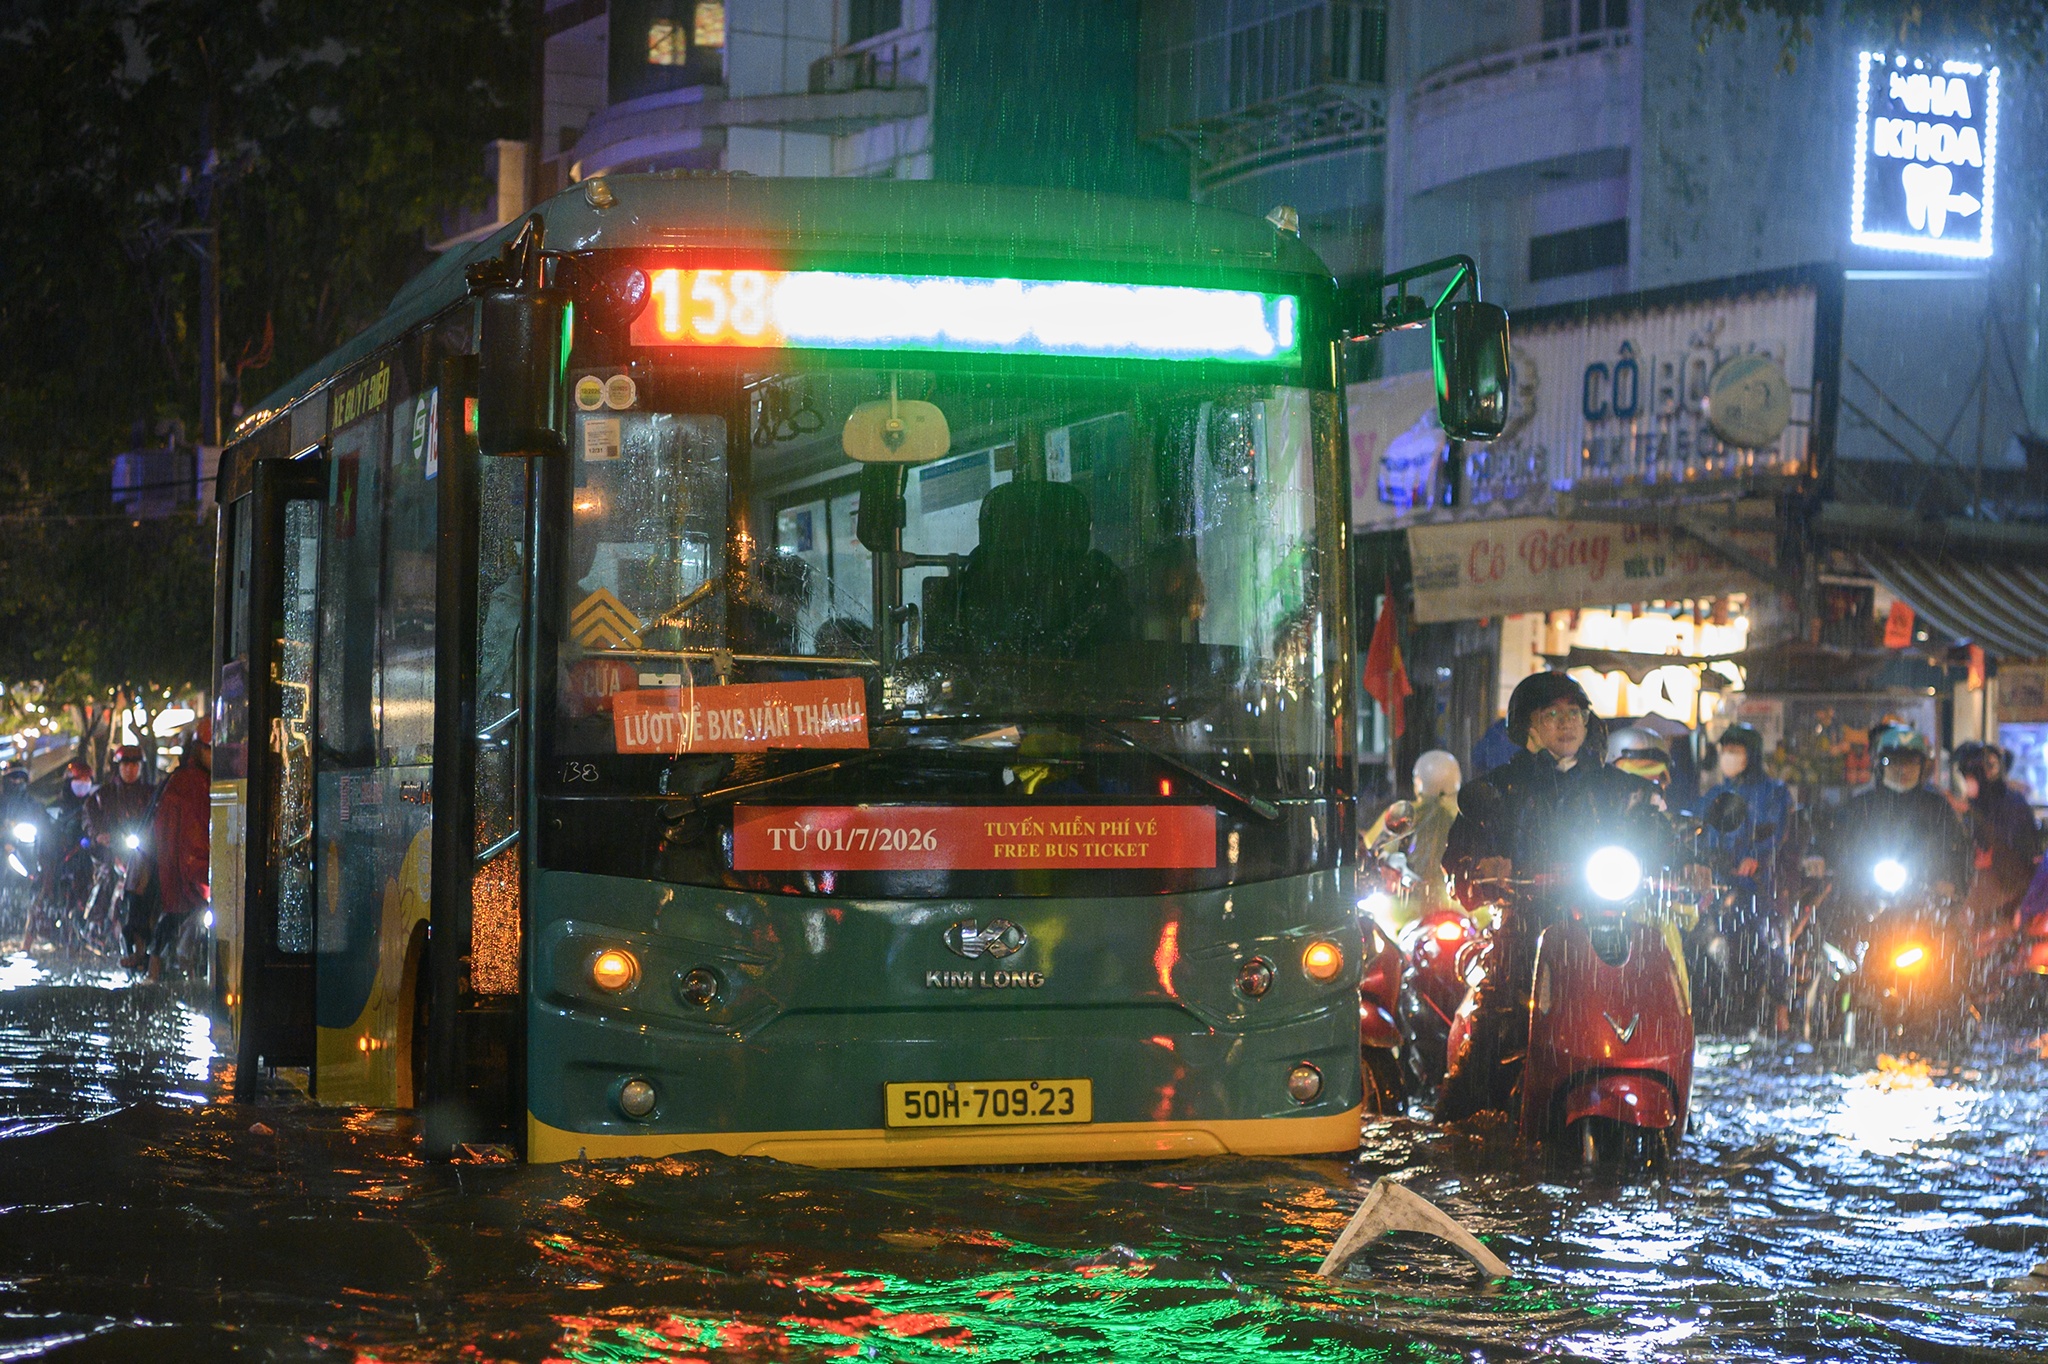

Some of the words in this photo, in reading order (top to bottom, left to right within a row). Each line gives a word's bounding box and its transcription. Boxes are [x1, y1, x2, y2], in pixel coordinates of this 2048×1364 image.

[1874, 117, 1983, 167] KHOA
[652, 268, 767, 335] 158
[1583, 341, 1640, 421] CÔ
[624, 710, 674, 752] LƯỢT
[677, 702, 704, 743] VỀ
[749, 700, 790, 738] VĂN
[793, 697, 862, 737] THÁNH
[767, 821, 811, 851] TỪ
[816, 828, 938, 851] 01/7/2026
[984, 816, 1045, 837] TUYẾN
[1049, 815, 1096, 836] MIỄN
[1100, 818, 1131, 836] PHÍ
[1135, 818, 1158, 836] VÉ
[993, 844, 1040, 858] FREE
[1045, 844, 1079, 858] BUS
[1083, 843, 1150, 858] TICKET
[925, 970, 973, 988] KIM
[980, 970, 1045, 988] LONG
[904, 1087, 1075, 1119] 50H-709.23
